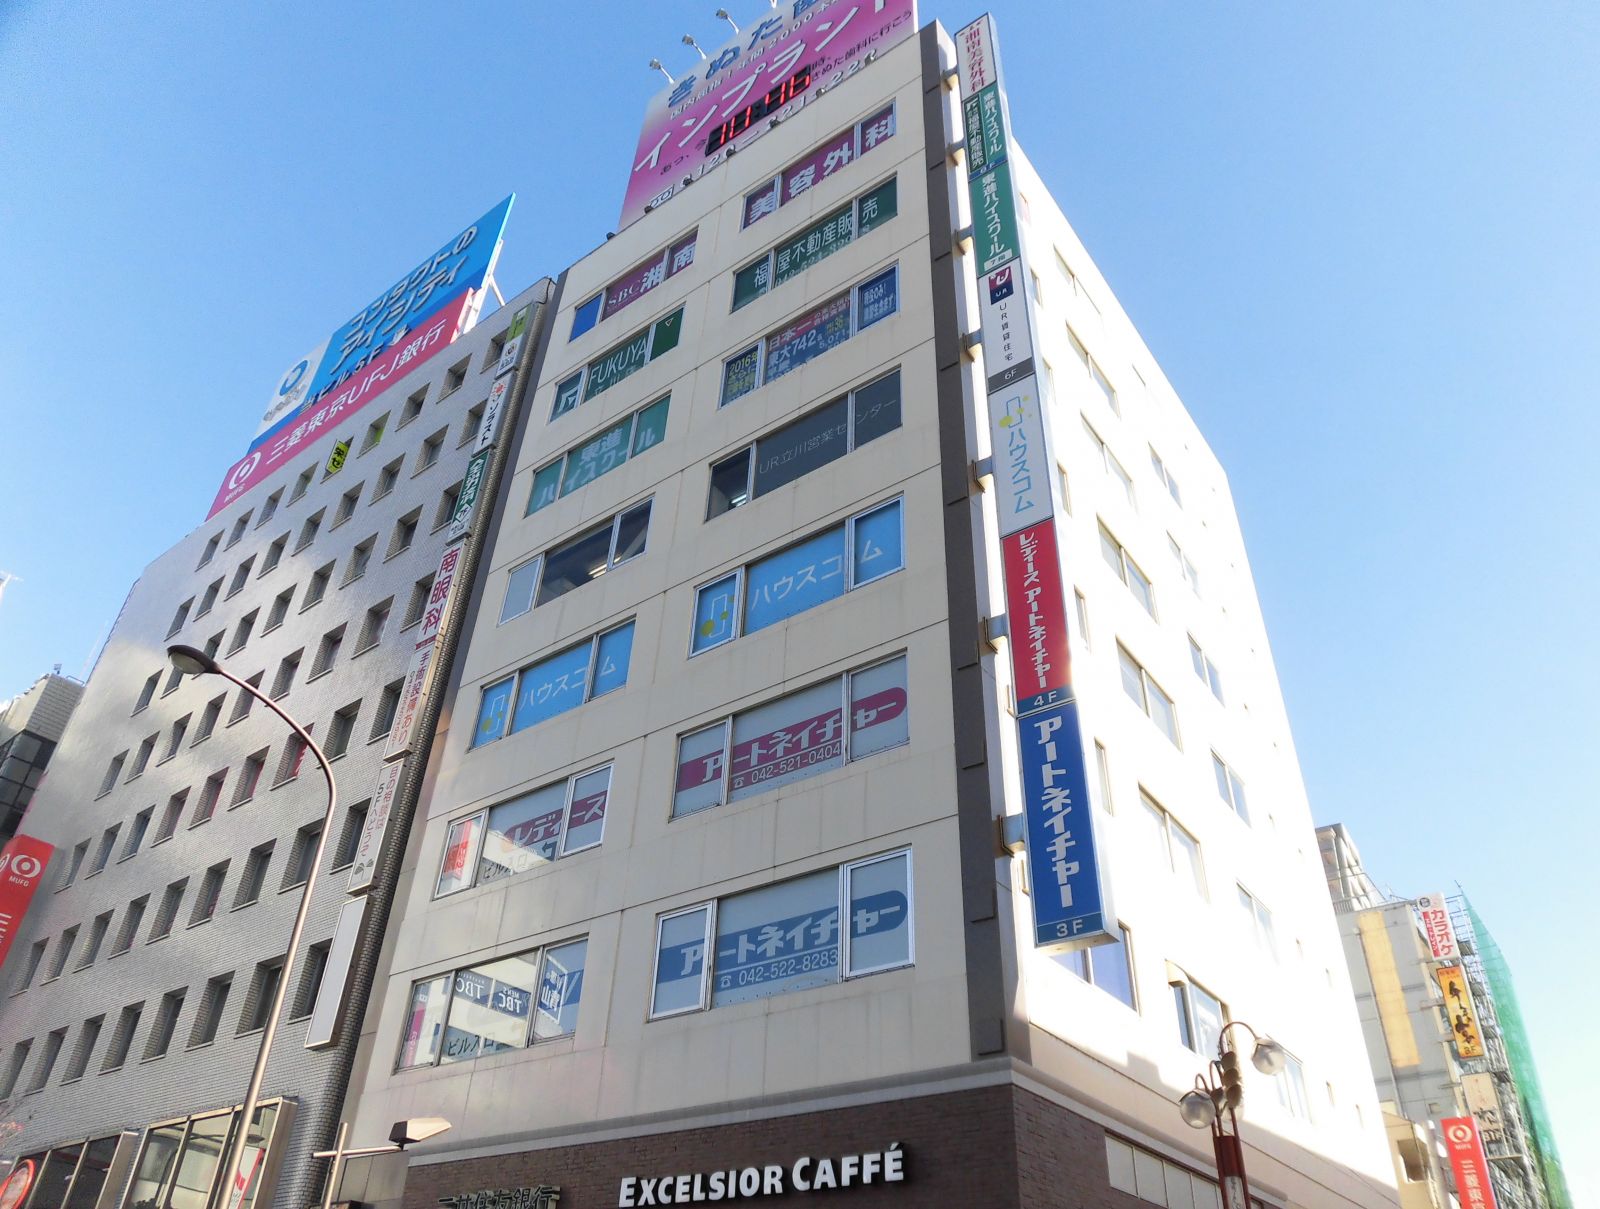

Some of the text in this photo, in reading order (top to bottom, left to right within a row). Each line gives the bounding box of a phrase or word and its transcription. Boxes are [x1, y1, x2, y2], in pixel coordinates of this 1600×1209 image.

[750, 113, 897, 223] 美容外科
[754, 196, 878, 289] 福屋不動産販売
[982, 172, 1005, 258] 東進ハイスクール
[345, 225, 478, 341] コンタクトの
[640, 241, 697, 293] 湘南
[330, 255, 469, 376] アイシティ
[768, 320, 812, 352] 日本一
[1000, 302, 1014, 361] UR賃貸住宅
[266, 318, 448, 466] 三菱東京UFJ銀行
[588, 336, 648, 389] FUKUYA
[1004, 367, 1018, 381] 6F
[758, 399, 897, 475] UR立川営業センター
[1007, 427, 1035, 514] ハウスコム
[422, 546, 460, 635] 南眼科
[751, 538, 885, 611] ハウスコム
[1024, 586, 1052, 689] アートネイチャー
[519, 655, 617, 712] ハウスコム
[1033, 690, 1058, 707] 4F
[702, 701, 898, 783] アートネイチャー
[750, 742, 841, 784] 042-521-0404
[514, 794, 608, 844] レディース
[1033, 715, 1080, 909] アートネイチャー
[9, 876, 30, 887] MUFG
[680, 905, 901, 977] アートネイチャー
[1056, 919, 1084, 938] 3F
[1430, 909, 1454, 956] カラオケ
[738, 949, 839, 987] 042-522-8283
[618, 1142, 904, 1208] EXCELSIOR CAFFÉ
